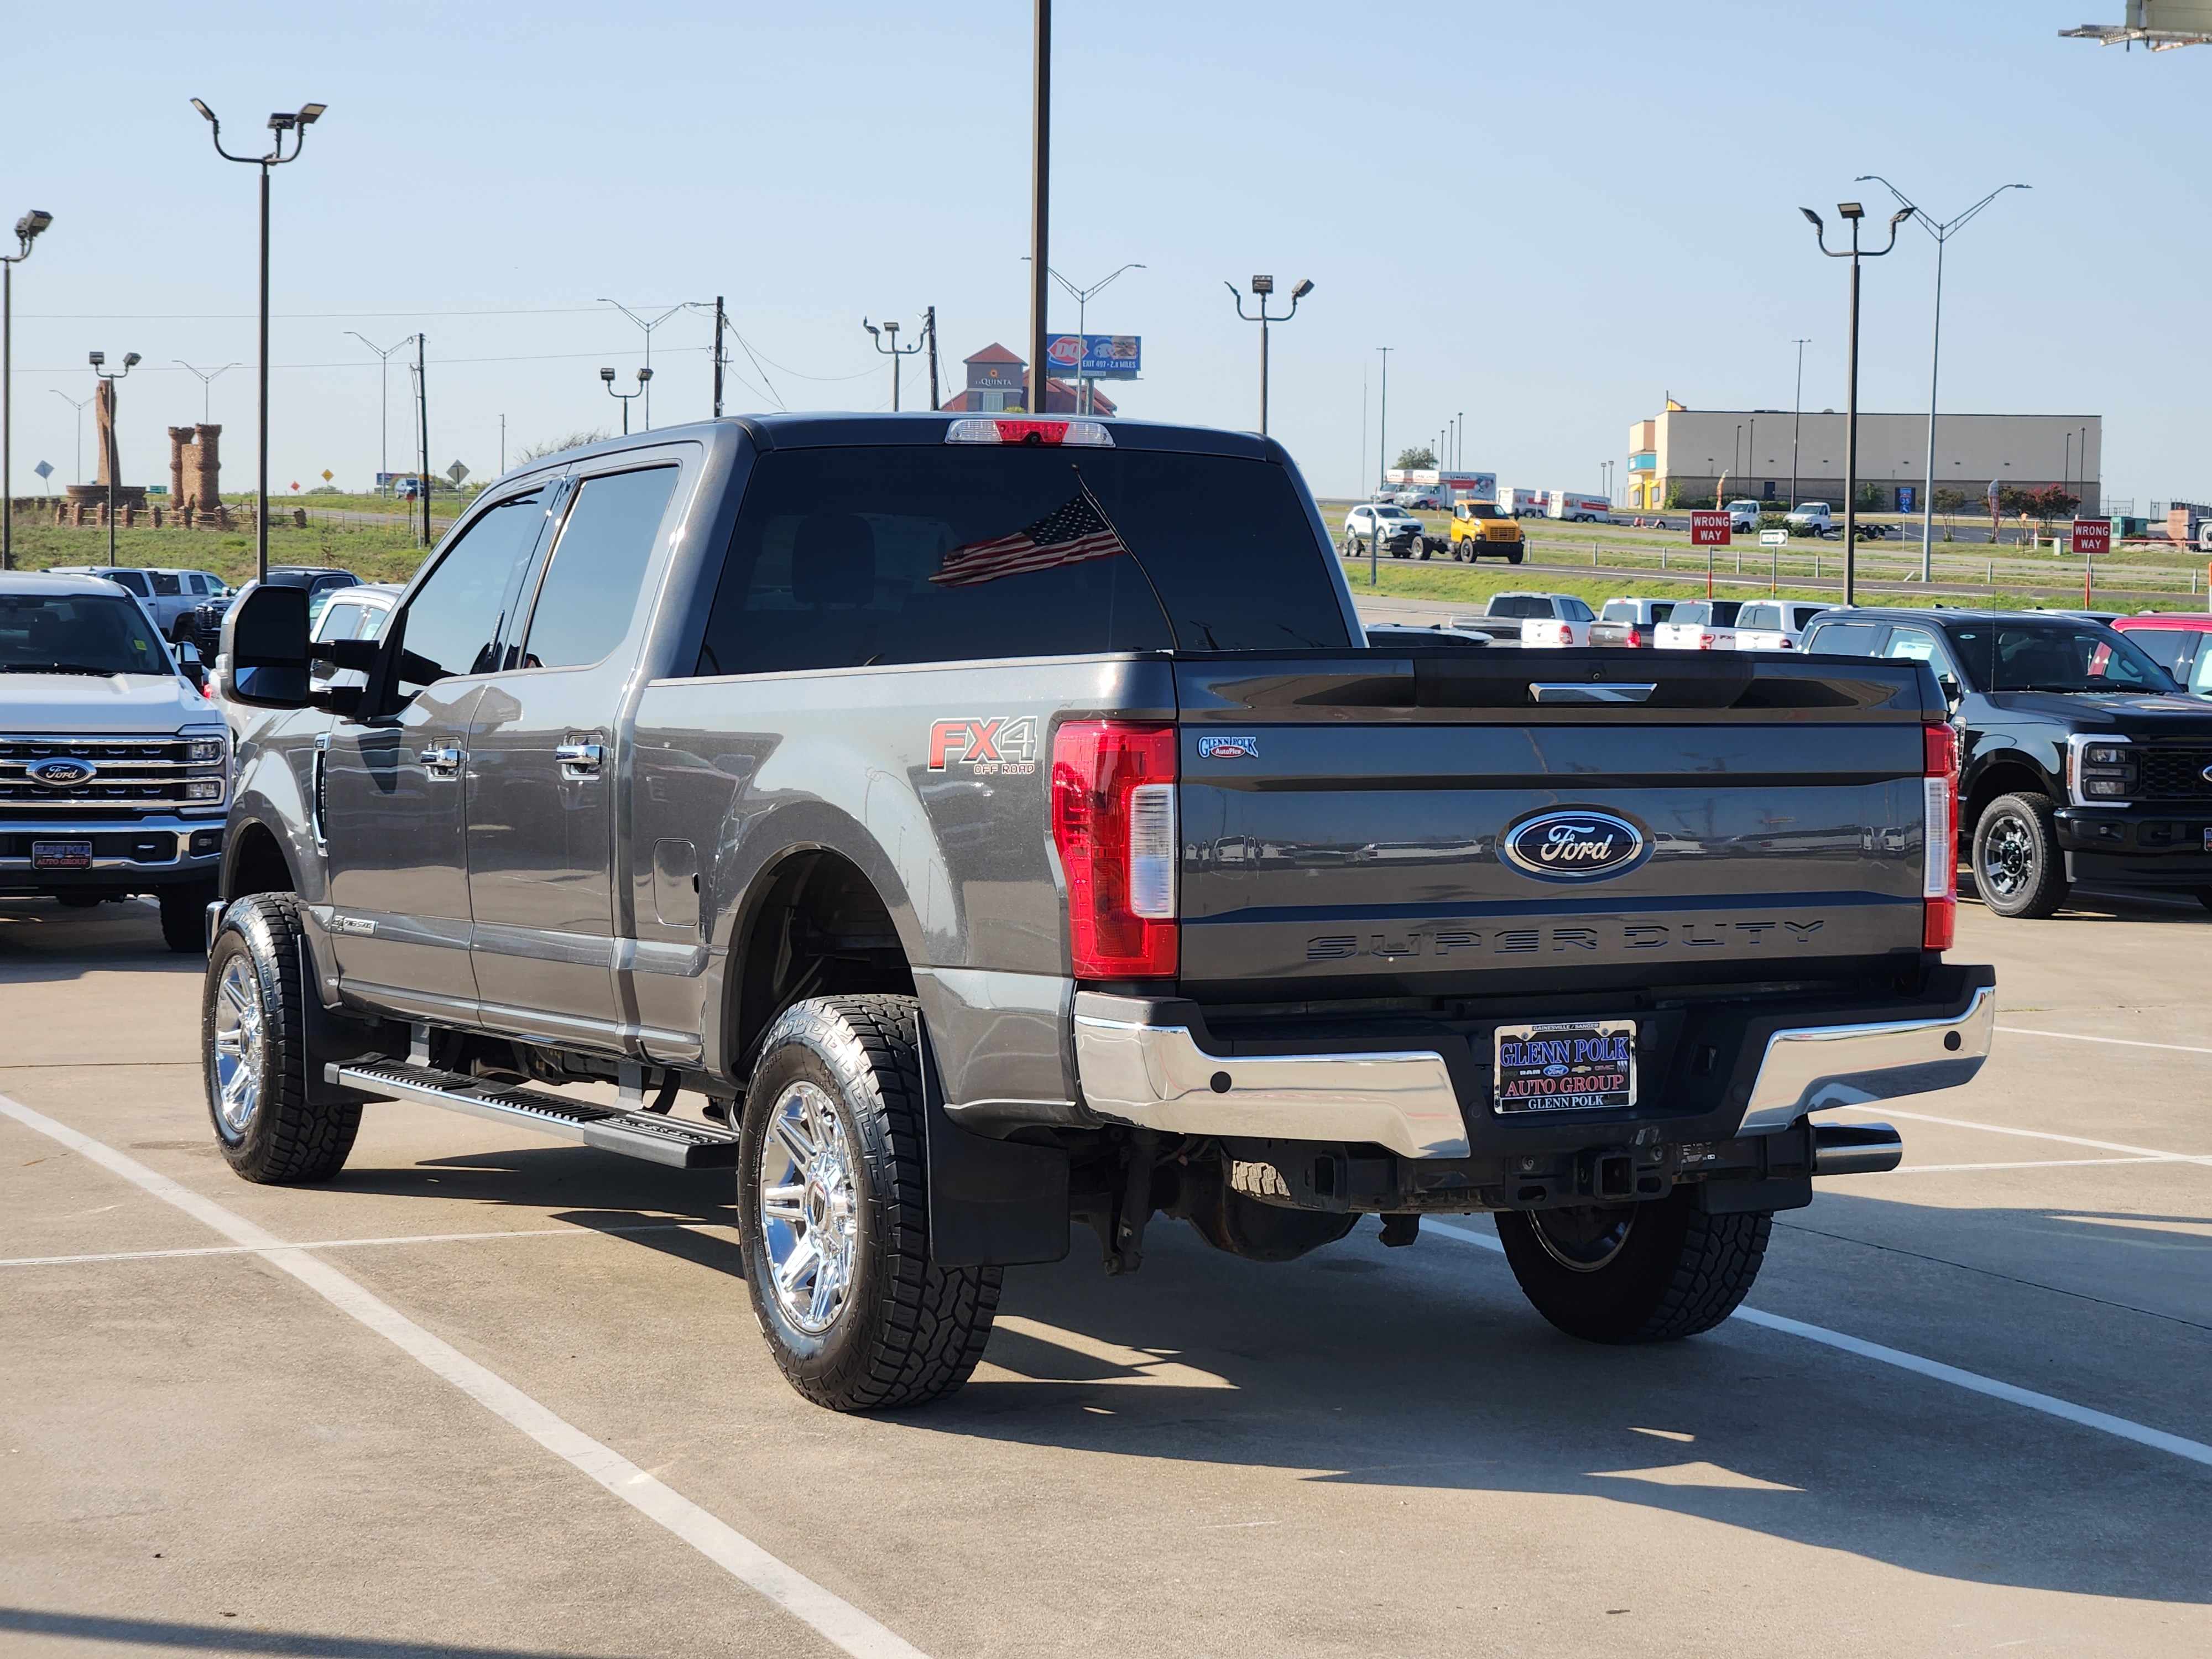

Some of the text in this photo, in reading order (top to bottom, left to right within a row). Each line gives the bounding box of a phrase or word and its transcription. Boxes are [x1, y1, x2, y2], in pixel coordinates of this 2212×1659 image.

[1693, 517, 1729, 527] WRONG
[1700, 530, 1722, 540] WAY
[2075, 526, 2109, 536] WRONG
[2081, 539, 2101, 549] WAY
[927, 716, 1037, 772] FX4
[1198, 737, 1259, 758] GLENN POLK
[46, 765, 78, 779] Ford
[974, 764, 1035, 774] OFF ROAD
[1540, 825, 1614, 861] Ford
[1307, 920, 1824, 960] SUPER DUTY
[1500, 1037, 1629, 1067] GLENN POLK
[1547, 1067, 1564, 1075] Ford
[1505, 1074, 1624, 1097] AUTO GROUP
[1528, 1095, 1604, 1109] GLENN POLK
